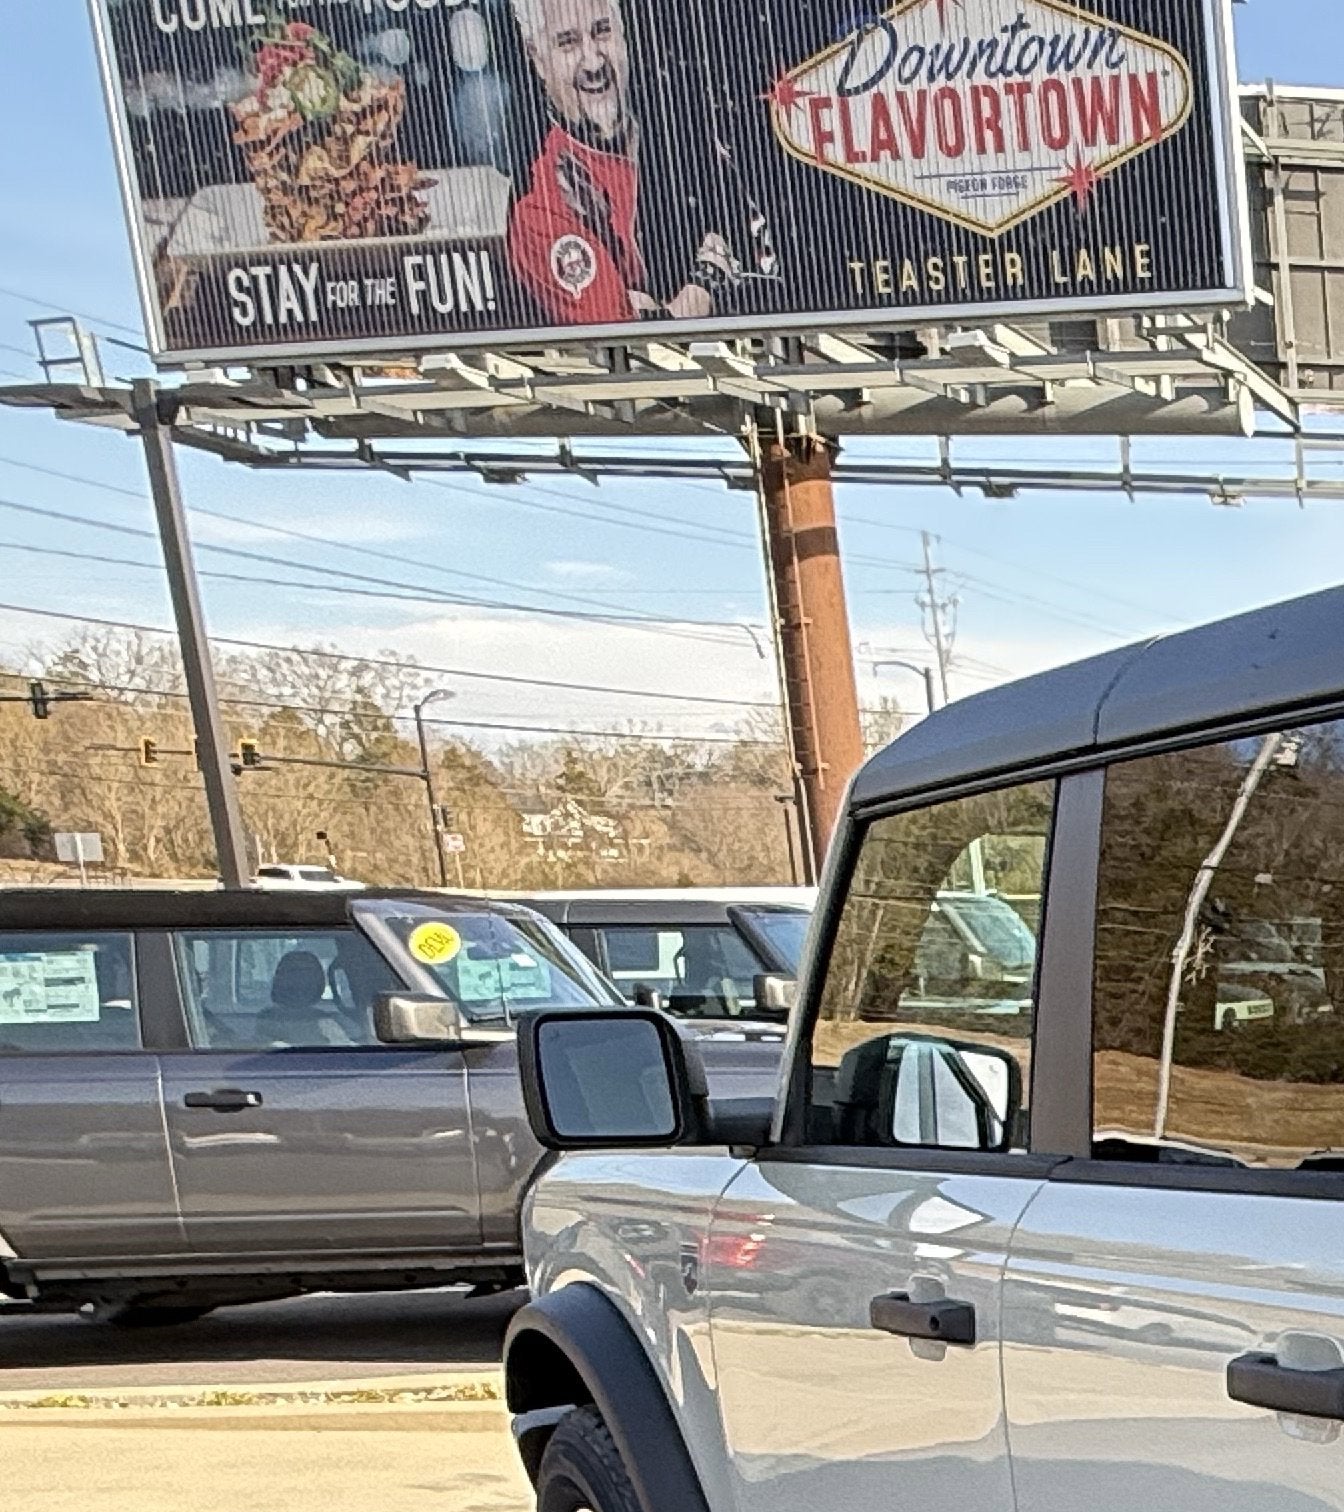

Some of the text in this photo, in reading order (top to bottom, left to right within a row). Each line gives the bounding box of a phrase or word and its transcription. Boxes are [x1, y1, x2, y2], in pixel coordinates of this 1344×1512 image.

[836, 14, 1127, 97] Downtown
[808, 71, 1163, 164] FLAVORTOWN
[228, 262, 319, 326] STAY
[326, 281, 360, 309] FOR
[364, 277, 397, 307] THE
[403, 250, 496, 316] FUN!
[849, 244, 1152, 294] TEASTER LANE
